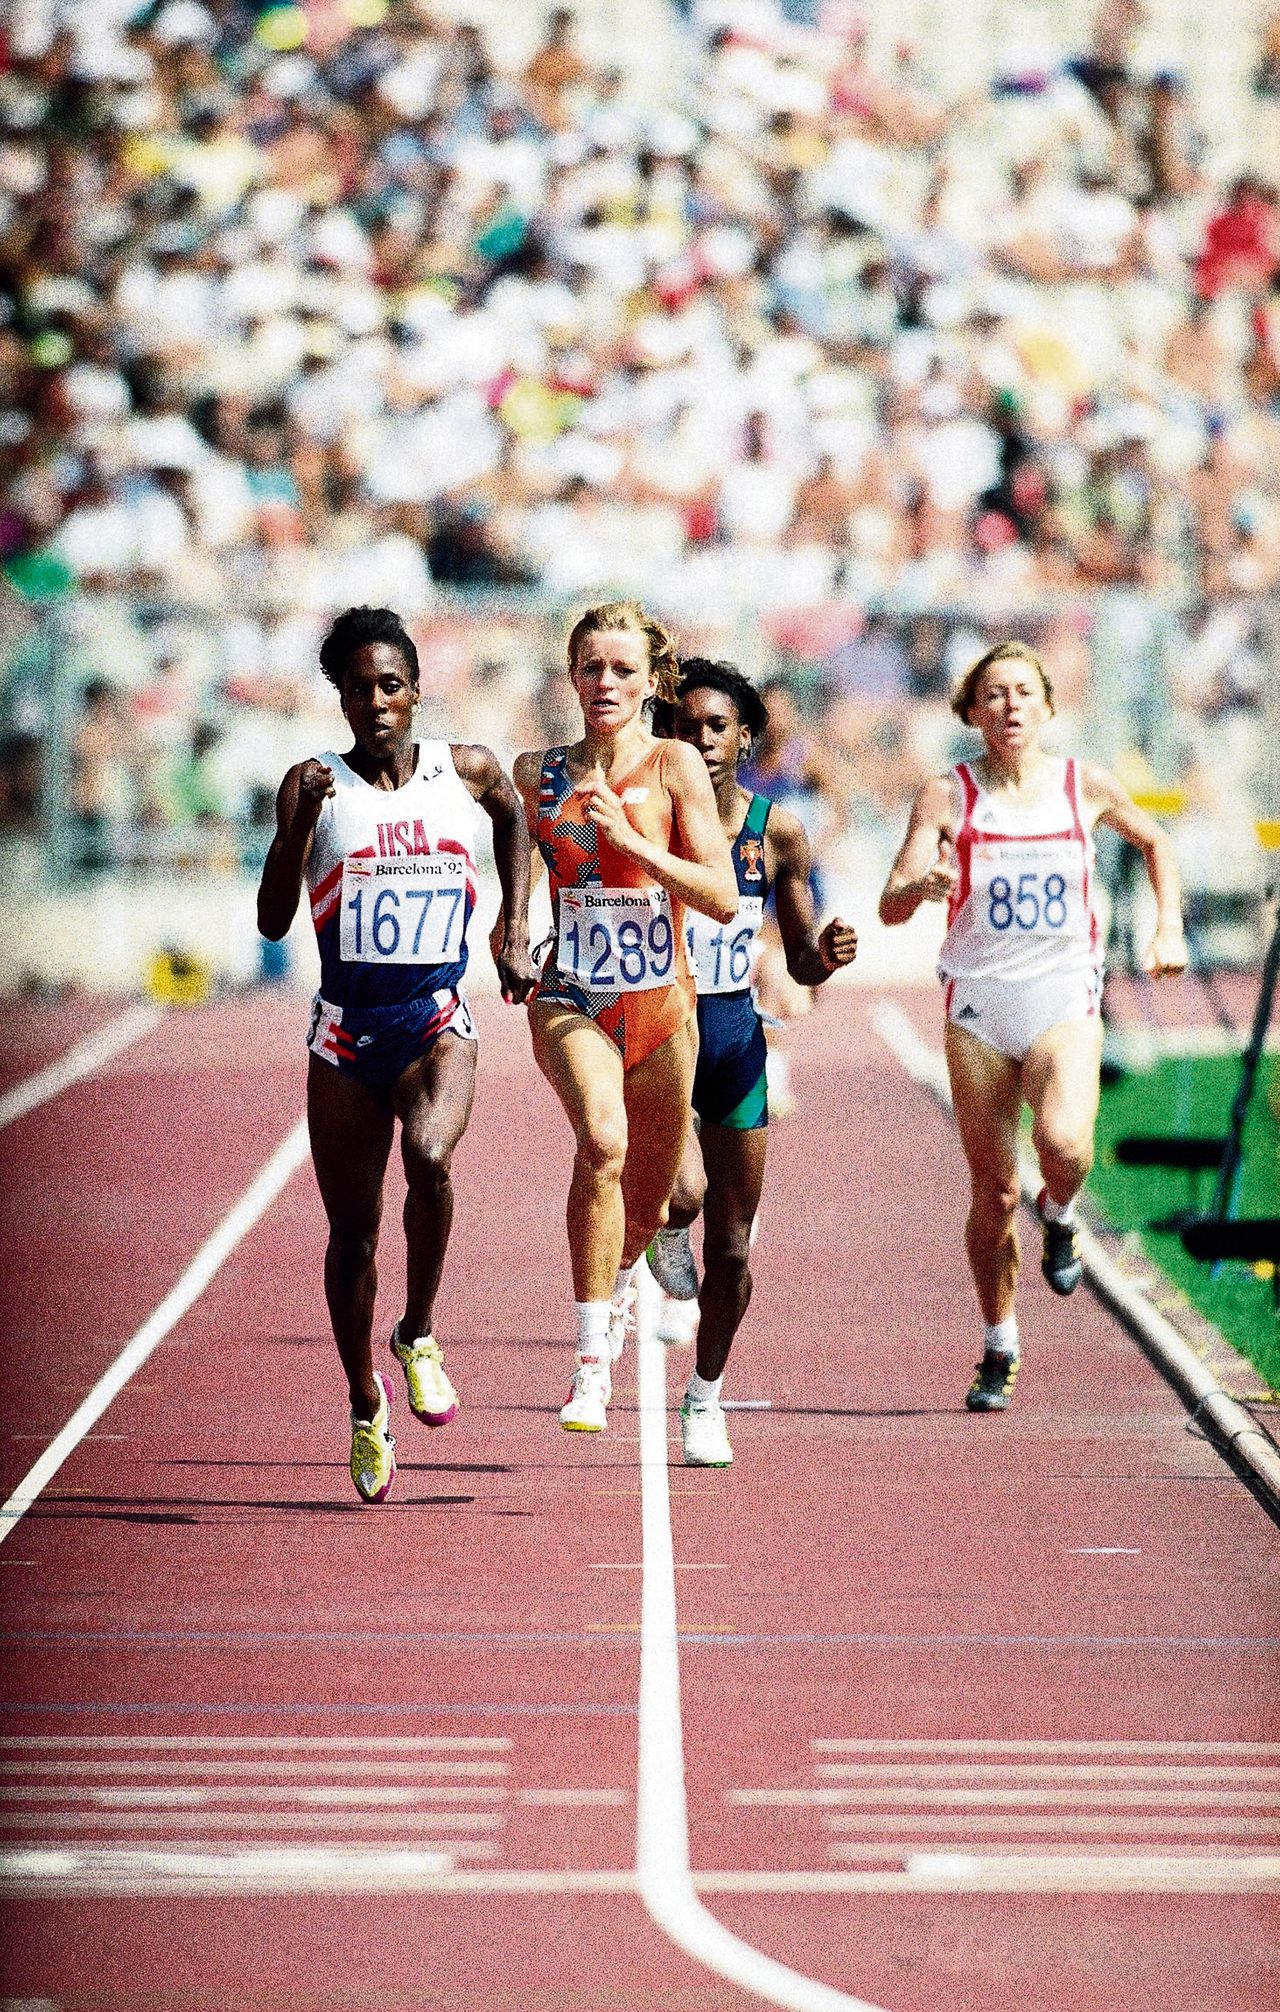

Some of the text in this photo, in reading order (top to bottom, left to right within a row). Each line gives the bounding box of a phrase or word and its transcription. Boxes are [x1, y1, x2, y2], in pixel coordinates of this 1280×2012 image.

[377, 819, 431, 857] USA
[375, 861, 463, 876] Barcelona '92
[348, 888, 463, 956] 1677
[584, 894, 651, 908] Barcelona
[988, 873, 1067, 931] 858
[566, 914, 674, 985] 1289
